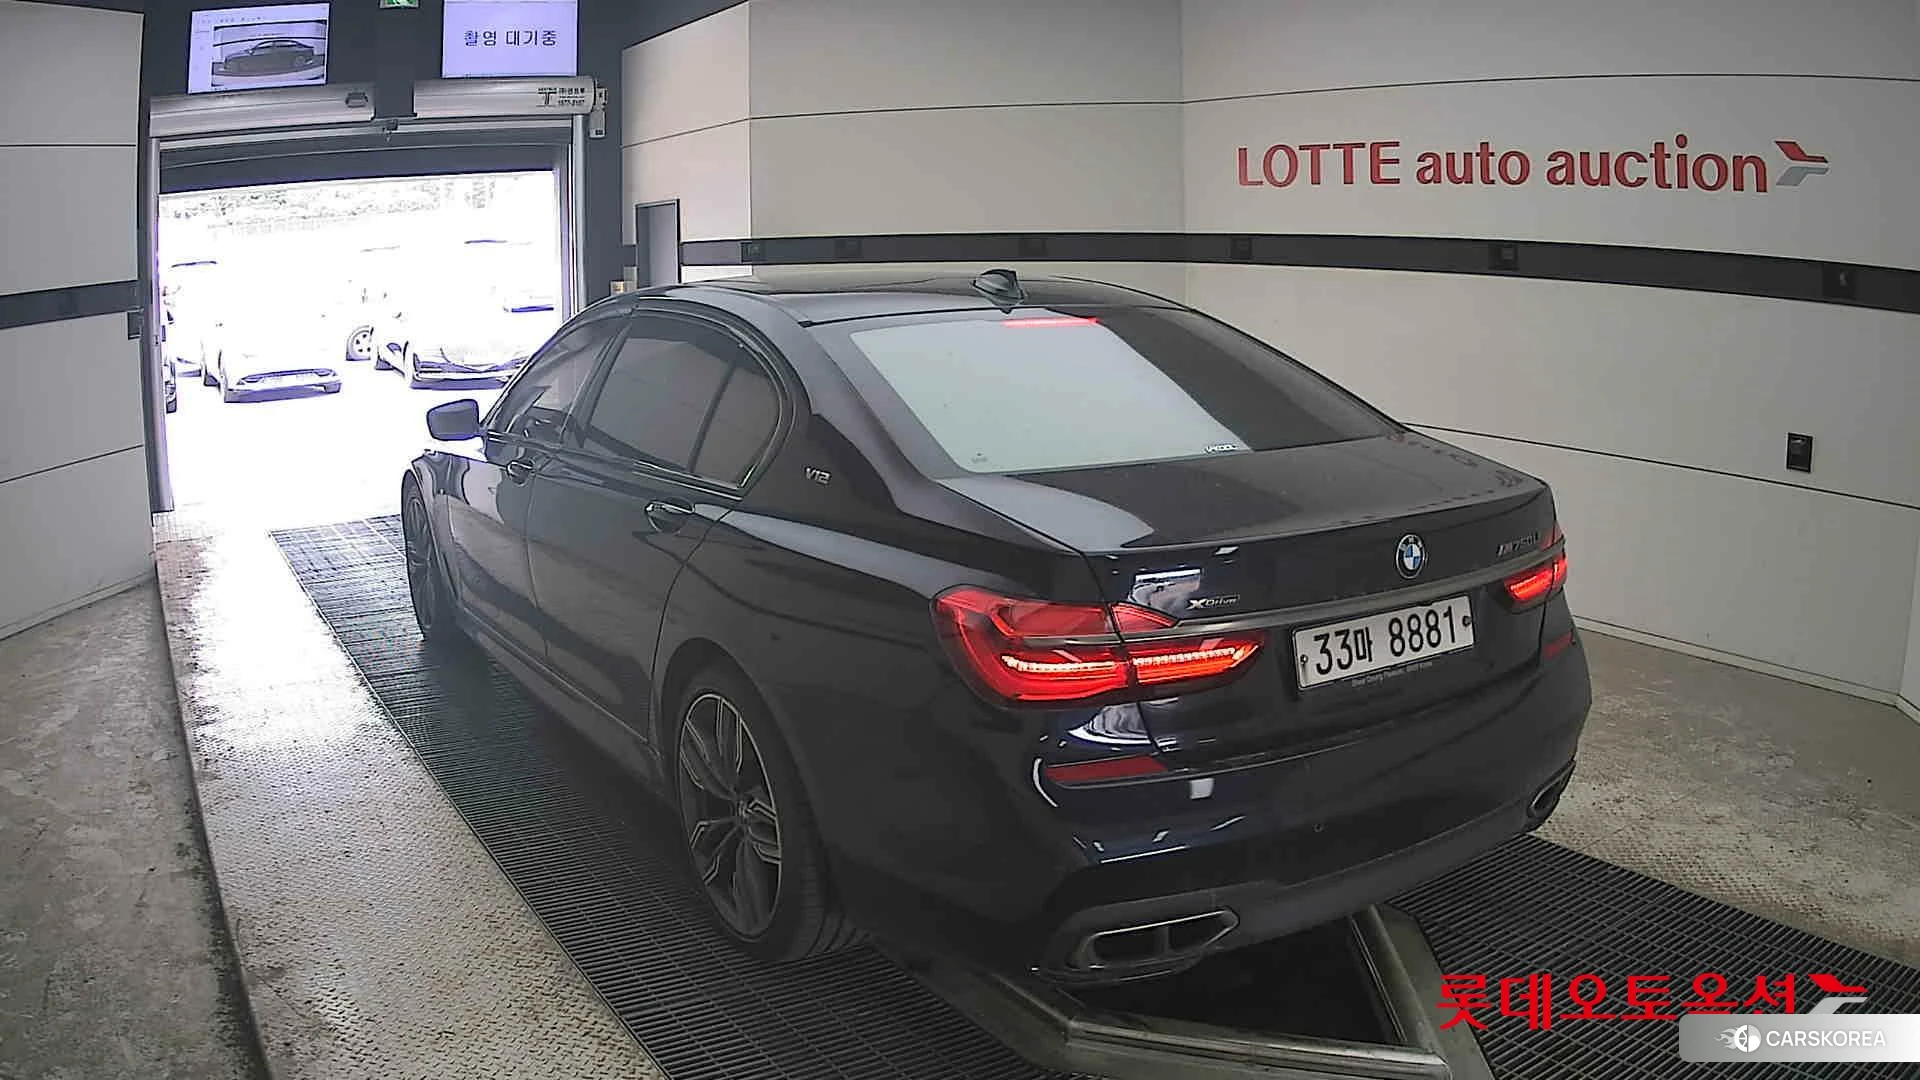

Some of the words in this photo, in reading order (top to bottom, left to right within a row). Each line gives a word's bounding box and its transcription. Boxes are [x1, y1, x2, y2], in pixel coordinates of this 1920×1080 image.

[464, 30, 497, 46] 촬영
[505, 30, 557, 46] 대기중
[1238, 140, 1400, 187] LOTTE
[1415, 141, 1530, 187] auto
[1546, 134, 1768, 193] auction
[805, 467, 831, 484] V12
[1313, 626, 1373, 675] 33마
[1388, 605, 1455, 657] 8881
